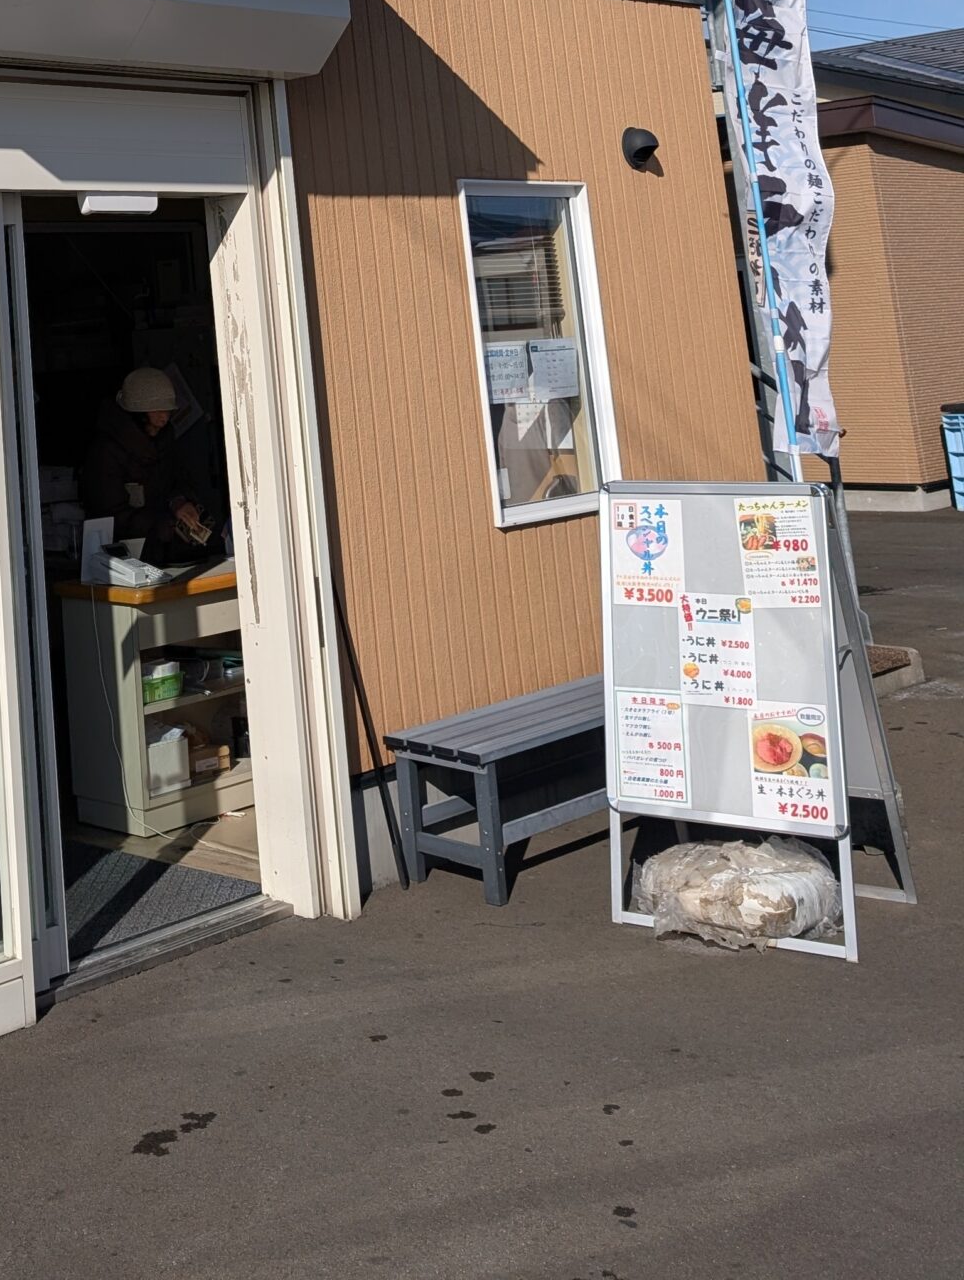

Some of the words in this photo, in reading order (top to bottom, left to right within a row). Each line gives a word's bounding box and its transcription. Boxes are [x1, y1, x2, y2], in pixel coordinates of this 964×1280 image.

[738, 500, 809, 511] たっちゃんラーメン
[771, 539, 809, 552] ¥980
[696, 607, 741, 622] ウニ祭り
